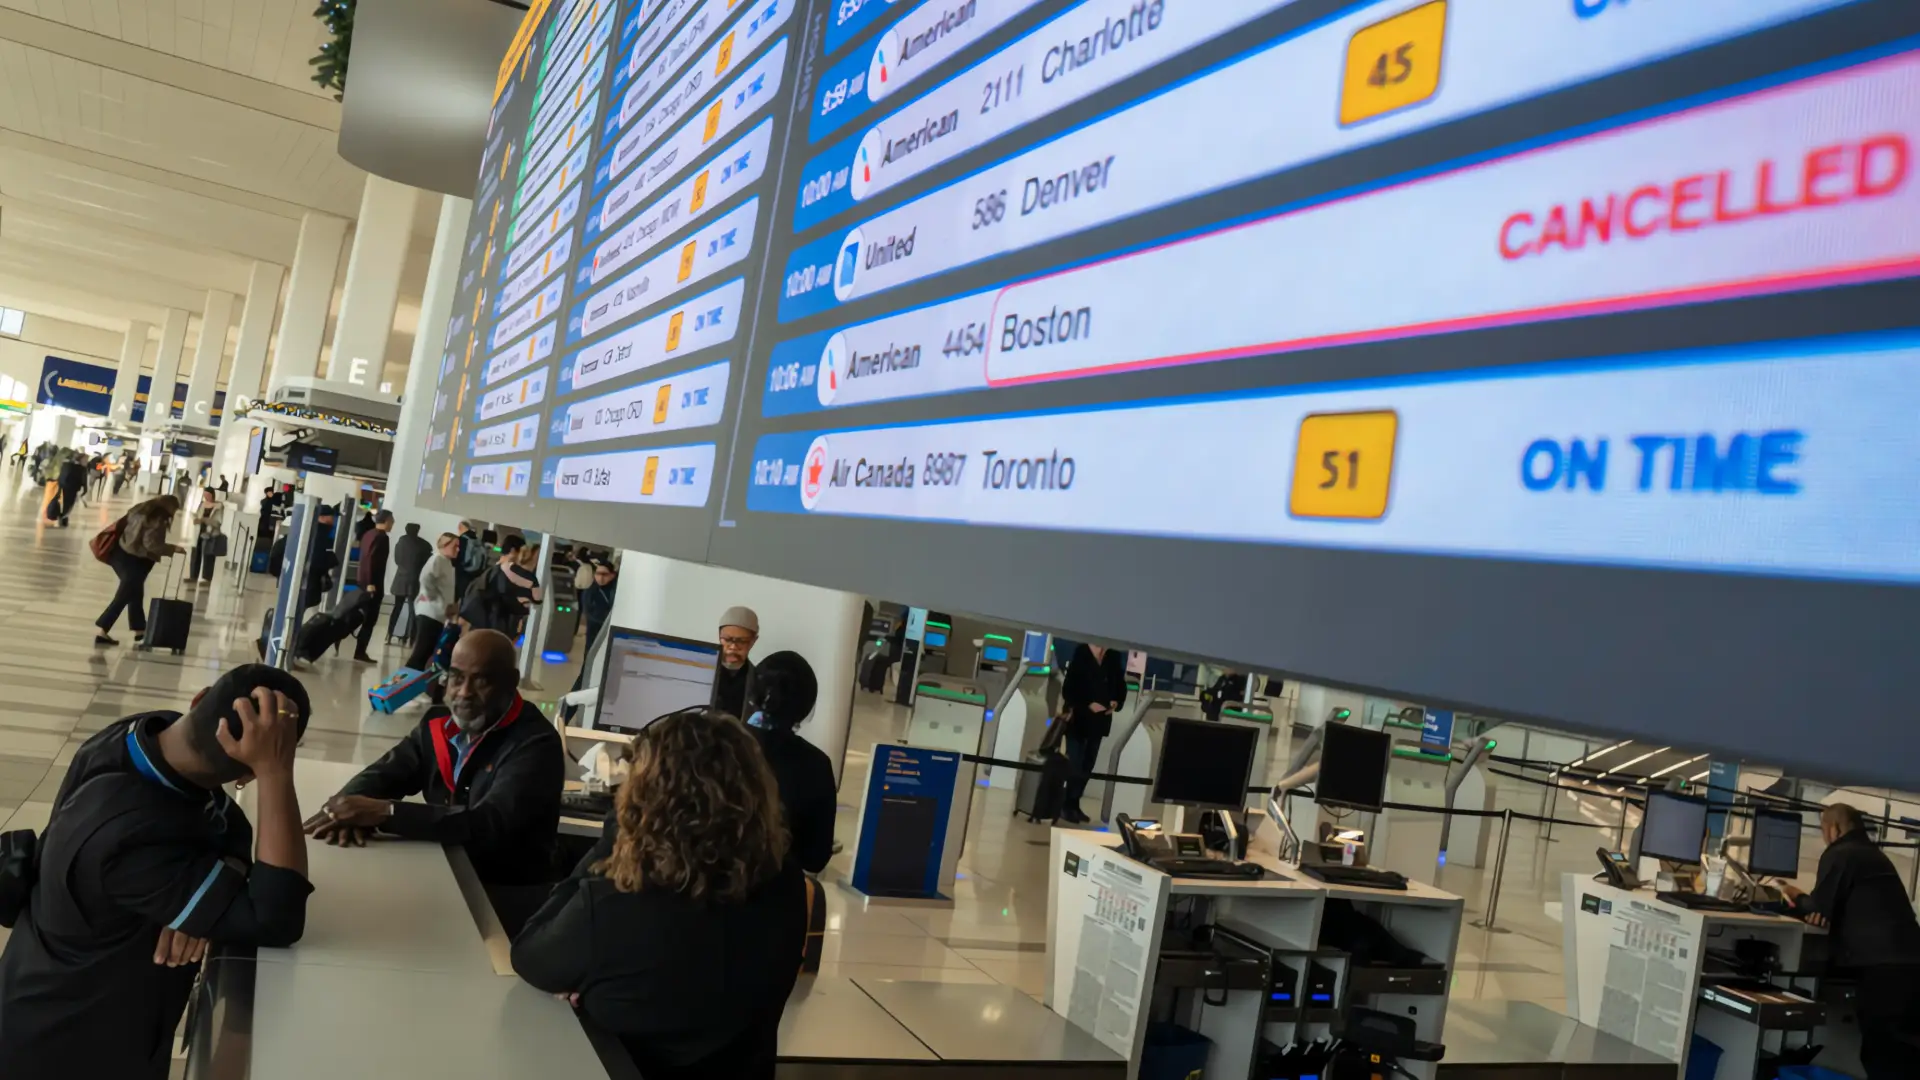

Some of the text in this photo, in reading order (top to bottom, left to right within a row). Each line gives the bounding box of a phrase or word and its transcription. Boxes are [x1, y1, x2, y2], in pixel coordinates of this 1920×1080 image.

[821, 78, 847, 116] 9:59
[898, 0, 977, 66] American
[882, 108, 959, 168] American
[979, 71, 1025, 114] 2111
[1041, 0, 1166, 84] Charlotte
[865, 225, 917, 270] United
[1020, 154, 1116, 216] Denver
[1366, 41, 1415, 89] 45
[846, 343, 921, 380] American
[942, 321, 986, 359] 4454
[1000, 305, 1091, 352] Boston
[1497, 132, 1909, 260] CANCELLED
[194, 400, 207, 415] C
[348, 357, 369, 386] E
[829, 458, 851, 488] Air
[855, 457, 915, 489] Canada
[982, 447, 1075, 491] Toronto
[1318, 449, 1361, 491] 51
[1520, 436, 1609, 492] ON
[1630, 430, 1806, 496] TIME
